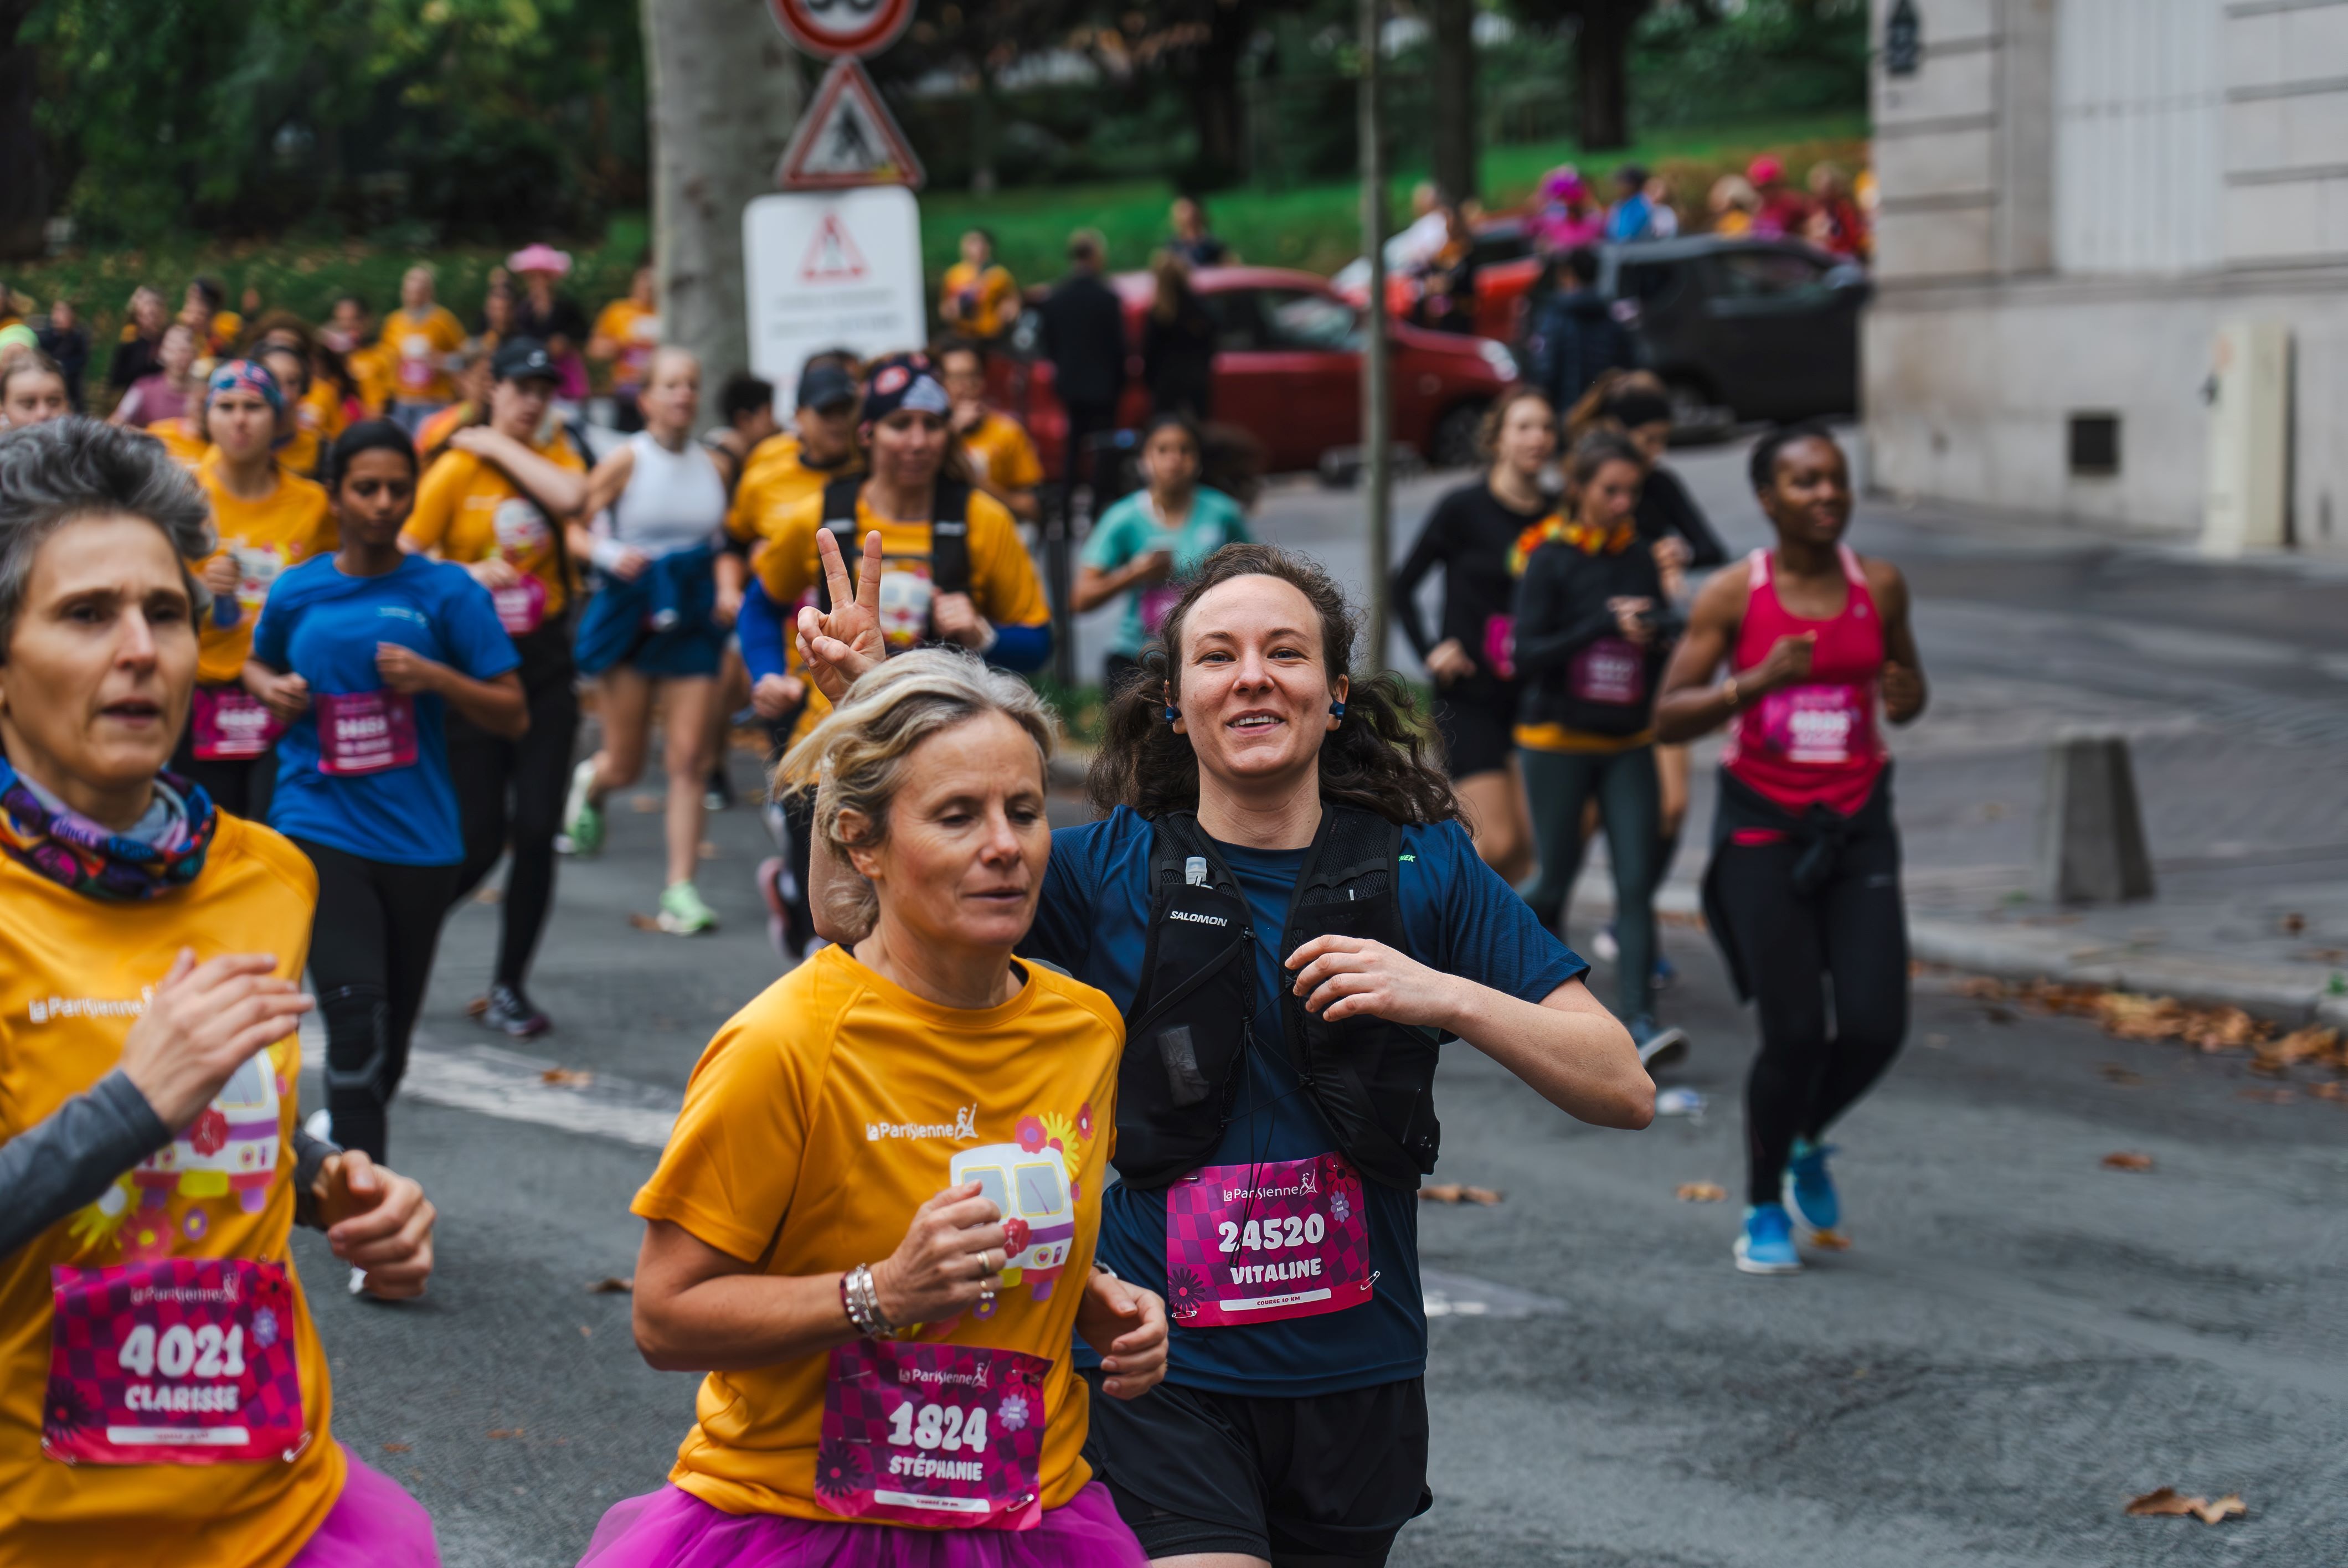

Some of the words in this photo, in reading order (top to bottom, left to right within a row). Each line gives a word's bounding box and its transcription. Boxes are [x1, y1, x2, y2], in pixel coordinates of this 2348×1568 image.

[1170, 911, 1228, 927] SALOMON
[1218, 1213, 1325, 1252] 24520
[1230, 1258, 1321, 1285] VITALINE
[118, 1324, 246, 1377] 4021
[125, 1385, 239, 1412] CLARISSE
[887, 1401, 987, 1453] 1824
[889, 1452, 984, 1481] STÉPHANIE
